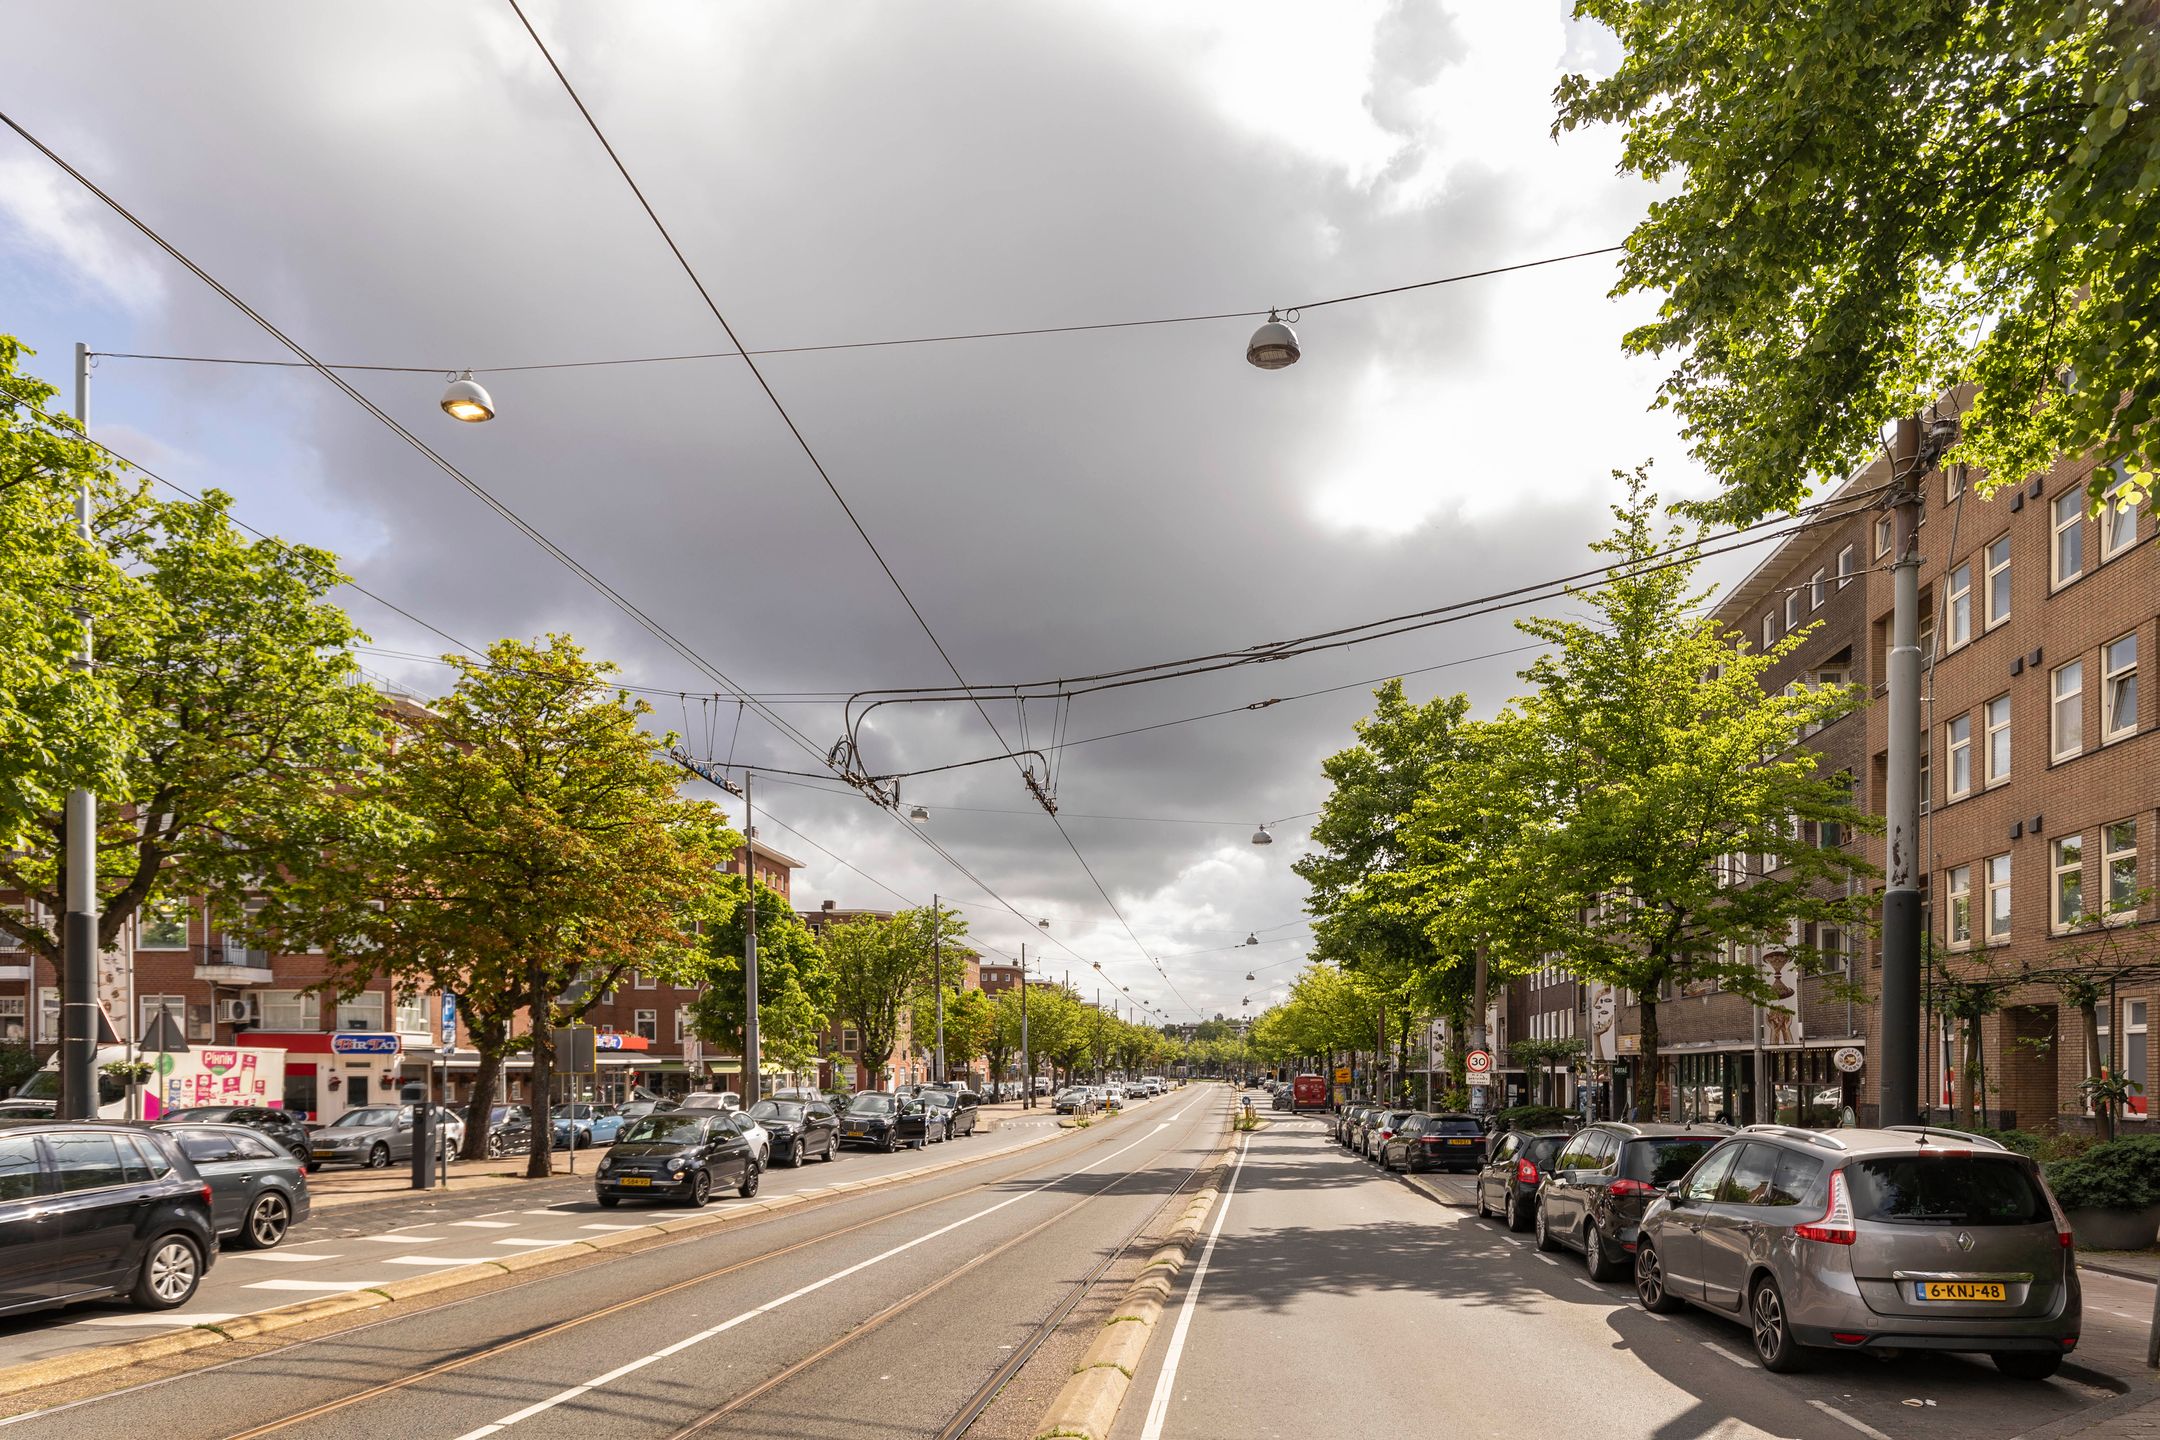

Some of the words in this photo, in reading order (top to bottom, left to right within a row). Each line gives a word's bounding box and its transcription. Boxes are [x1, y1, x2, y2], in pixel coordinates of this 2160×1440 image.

[445, 996, 452, 1015] P
[1472, 1058, 1486, 1066] 30
[1931, 1284, 2000, 1298] 6-KNJ-48
